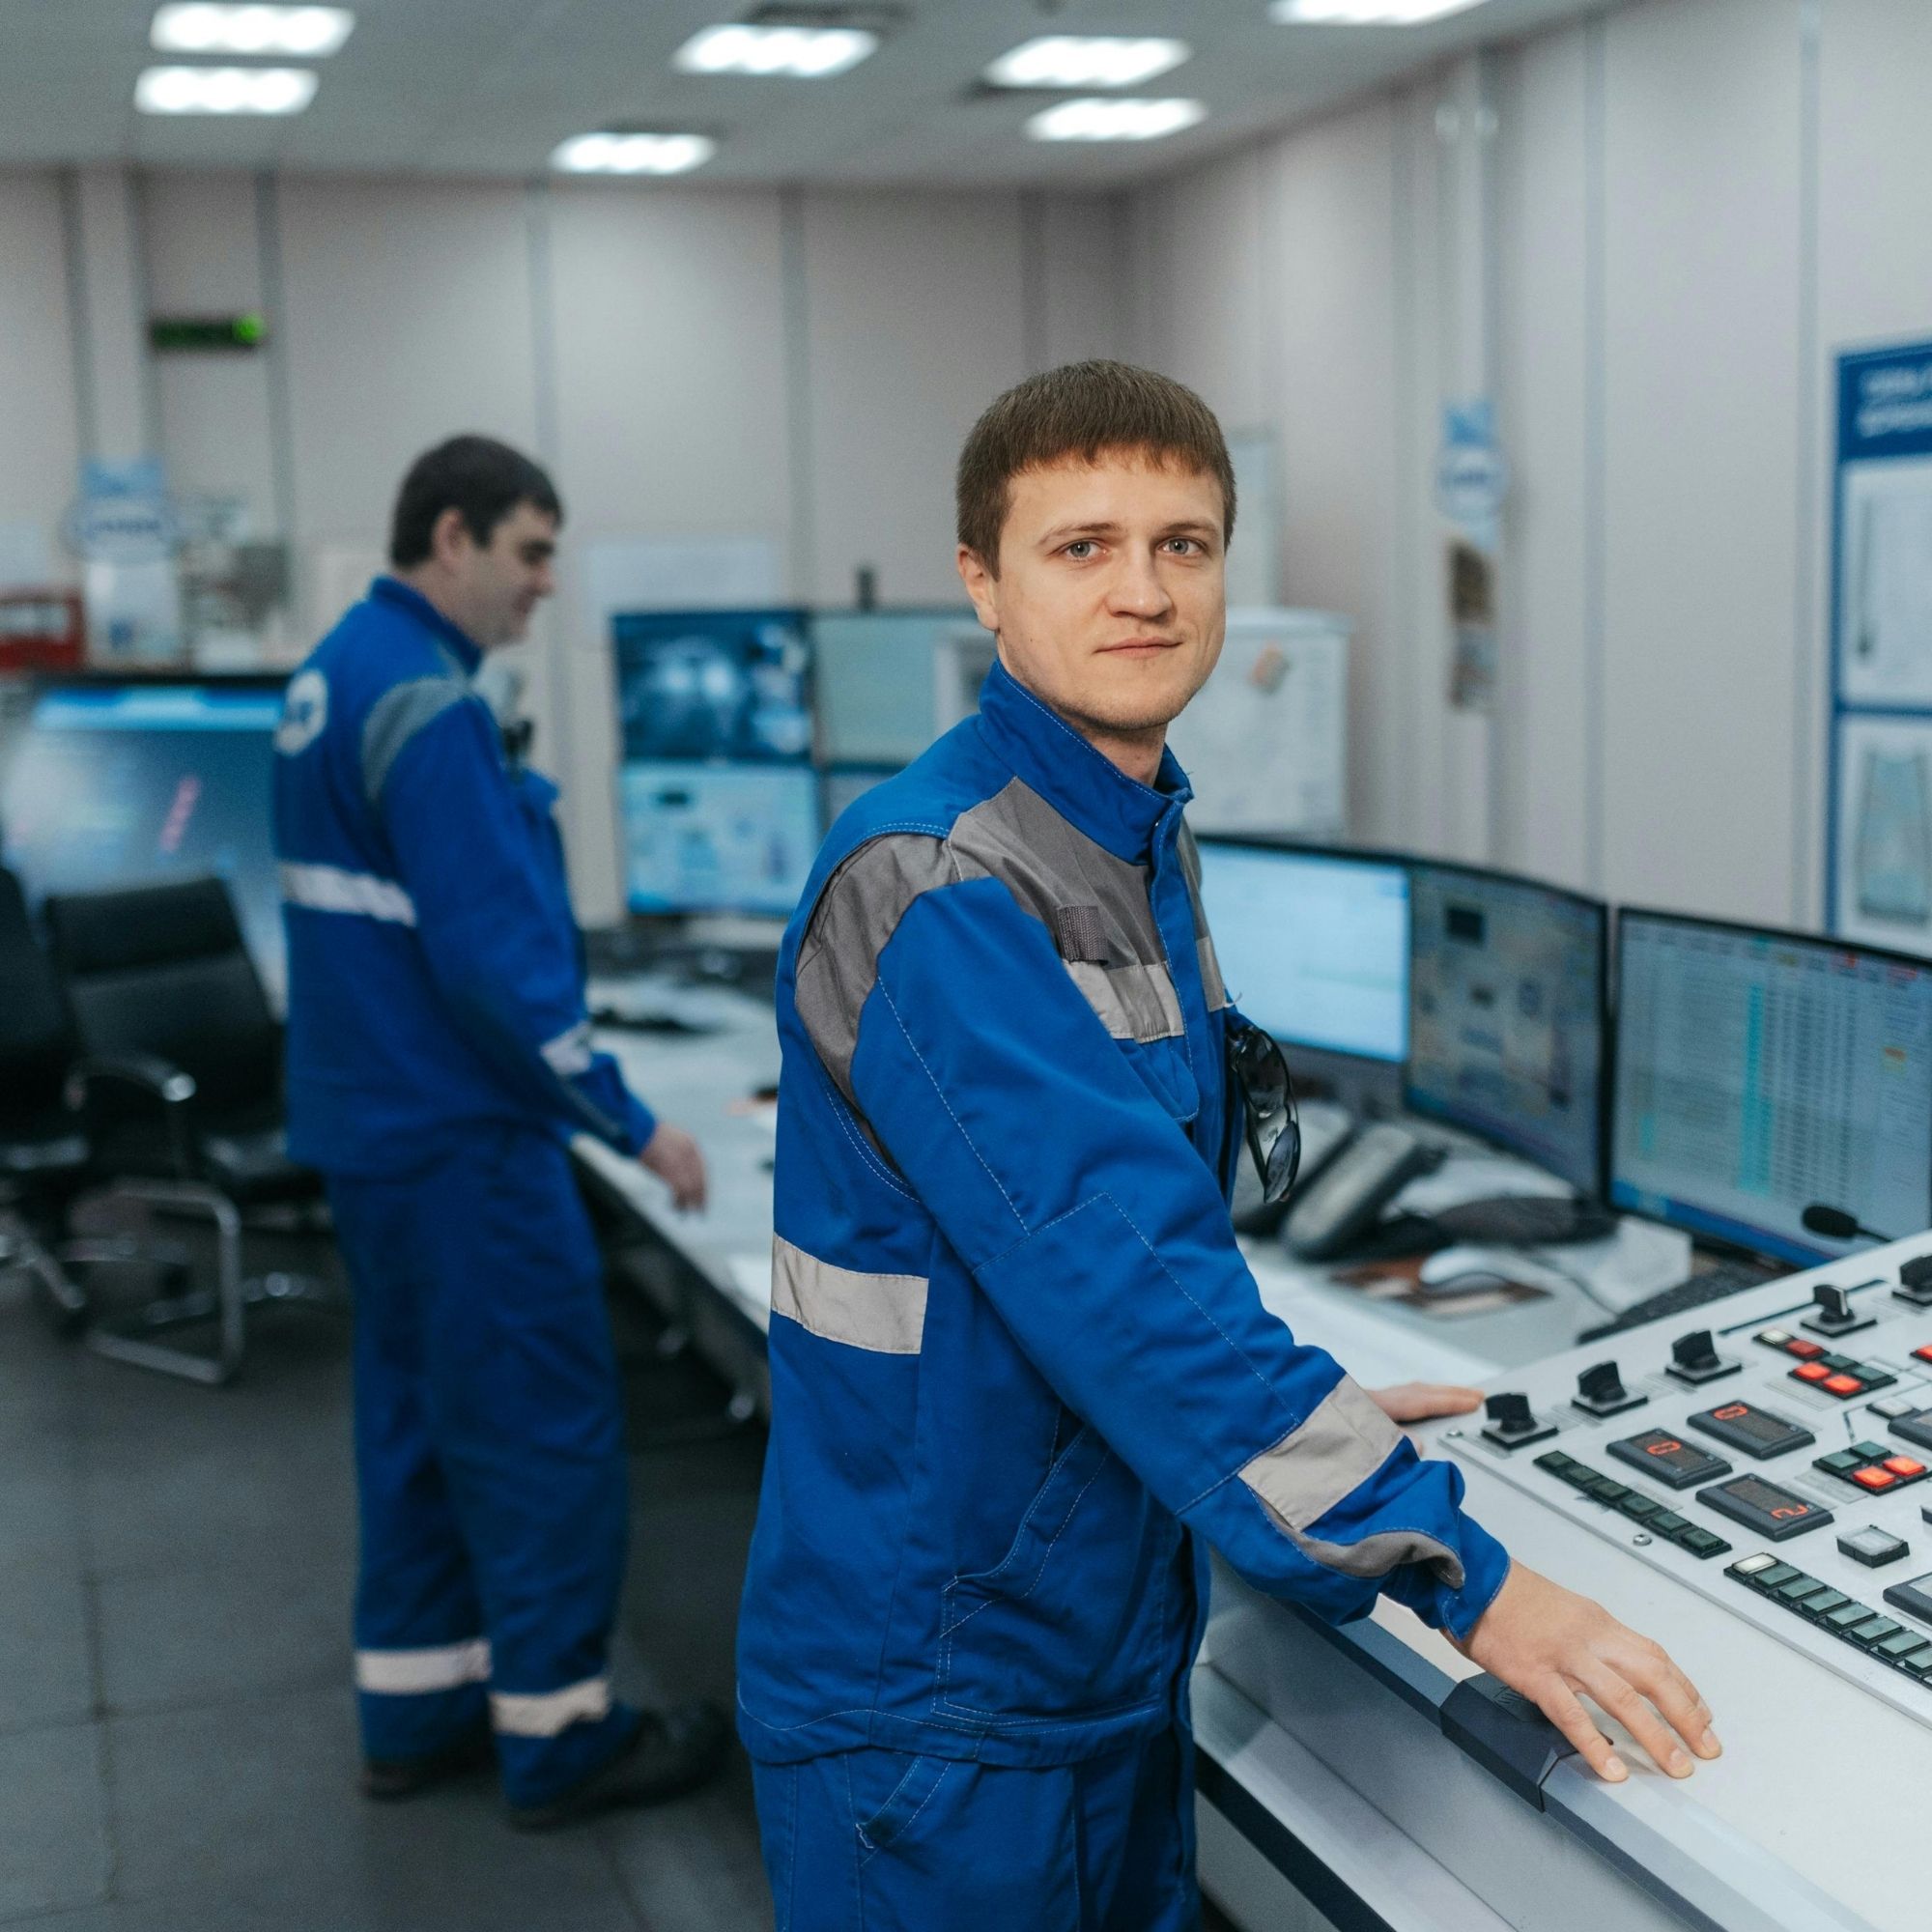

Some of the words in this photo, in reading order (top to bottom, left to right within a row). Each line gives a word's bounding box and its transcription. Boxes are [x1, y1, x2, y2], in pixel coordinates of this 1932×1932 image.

[1714, 1405, 1748, 1421] 0
[1646, 1439, 1682, 1456] 0
[1771, 1503, 1809, 1520] 2
